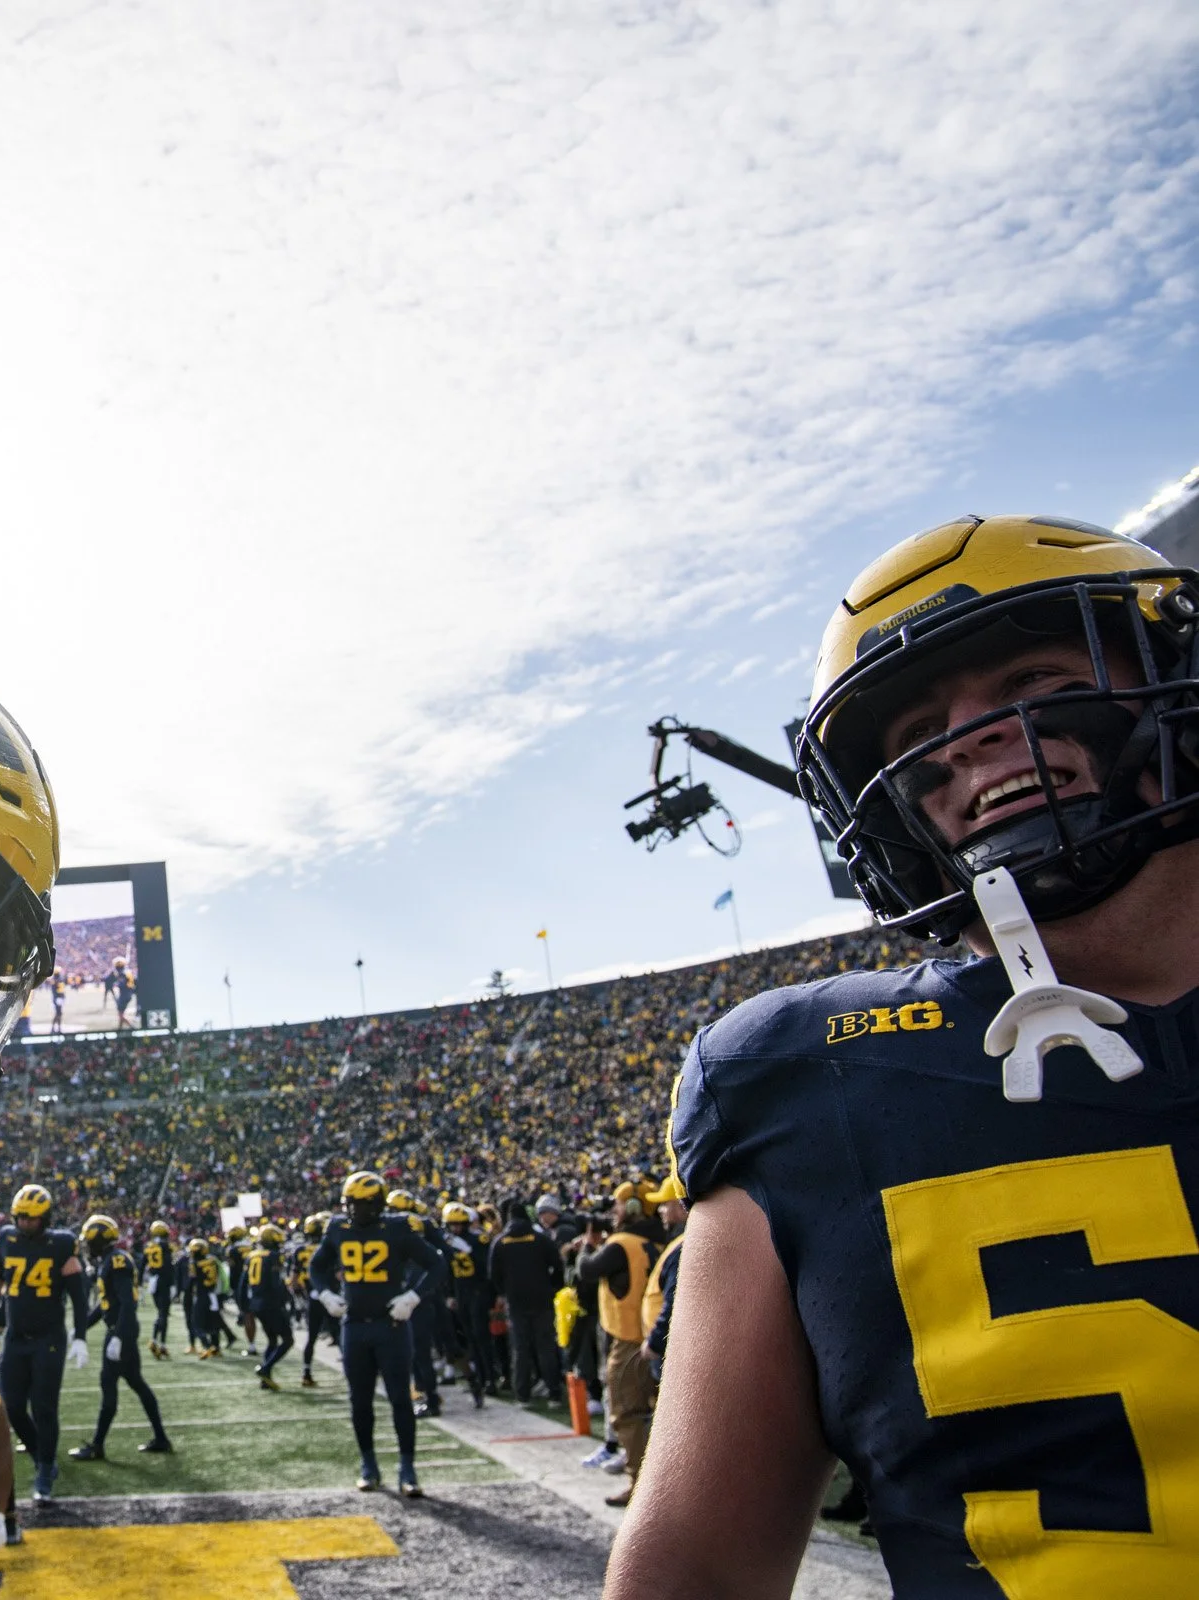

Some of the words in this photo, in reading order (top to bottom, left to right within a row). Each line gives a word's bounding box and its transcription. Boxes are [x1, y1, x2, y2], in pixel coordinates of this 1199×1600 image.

[878, 595, 947, 636] MICHIGAN
[142, 926, 163, 941] M
[4, 1256, 54, 1297] 74
[340, 1240, 389, 1283] 92
